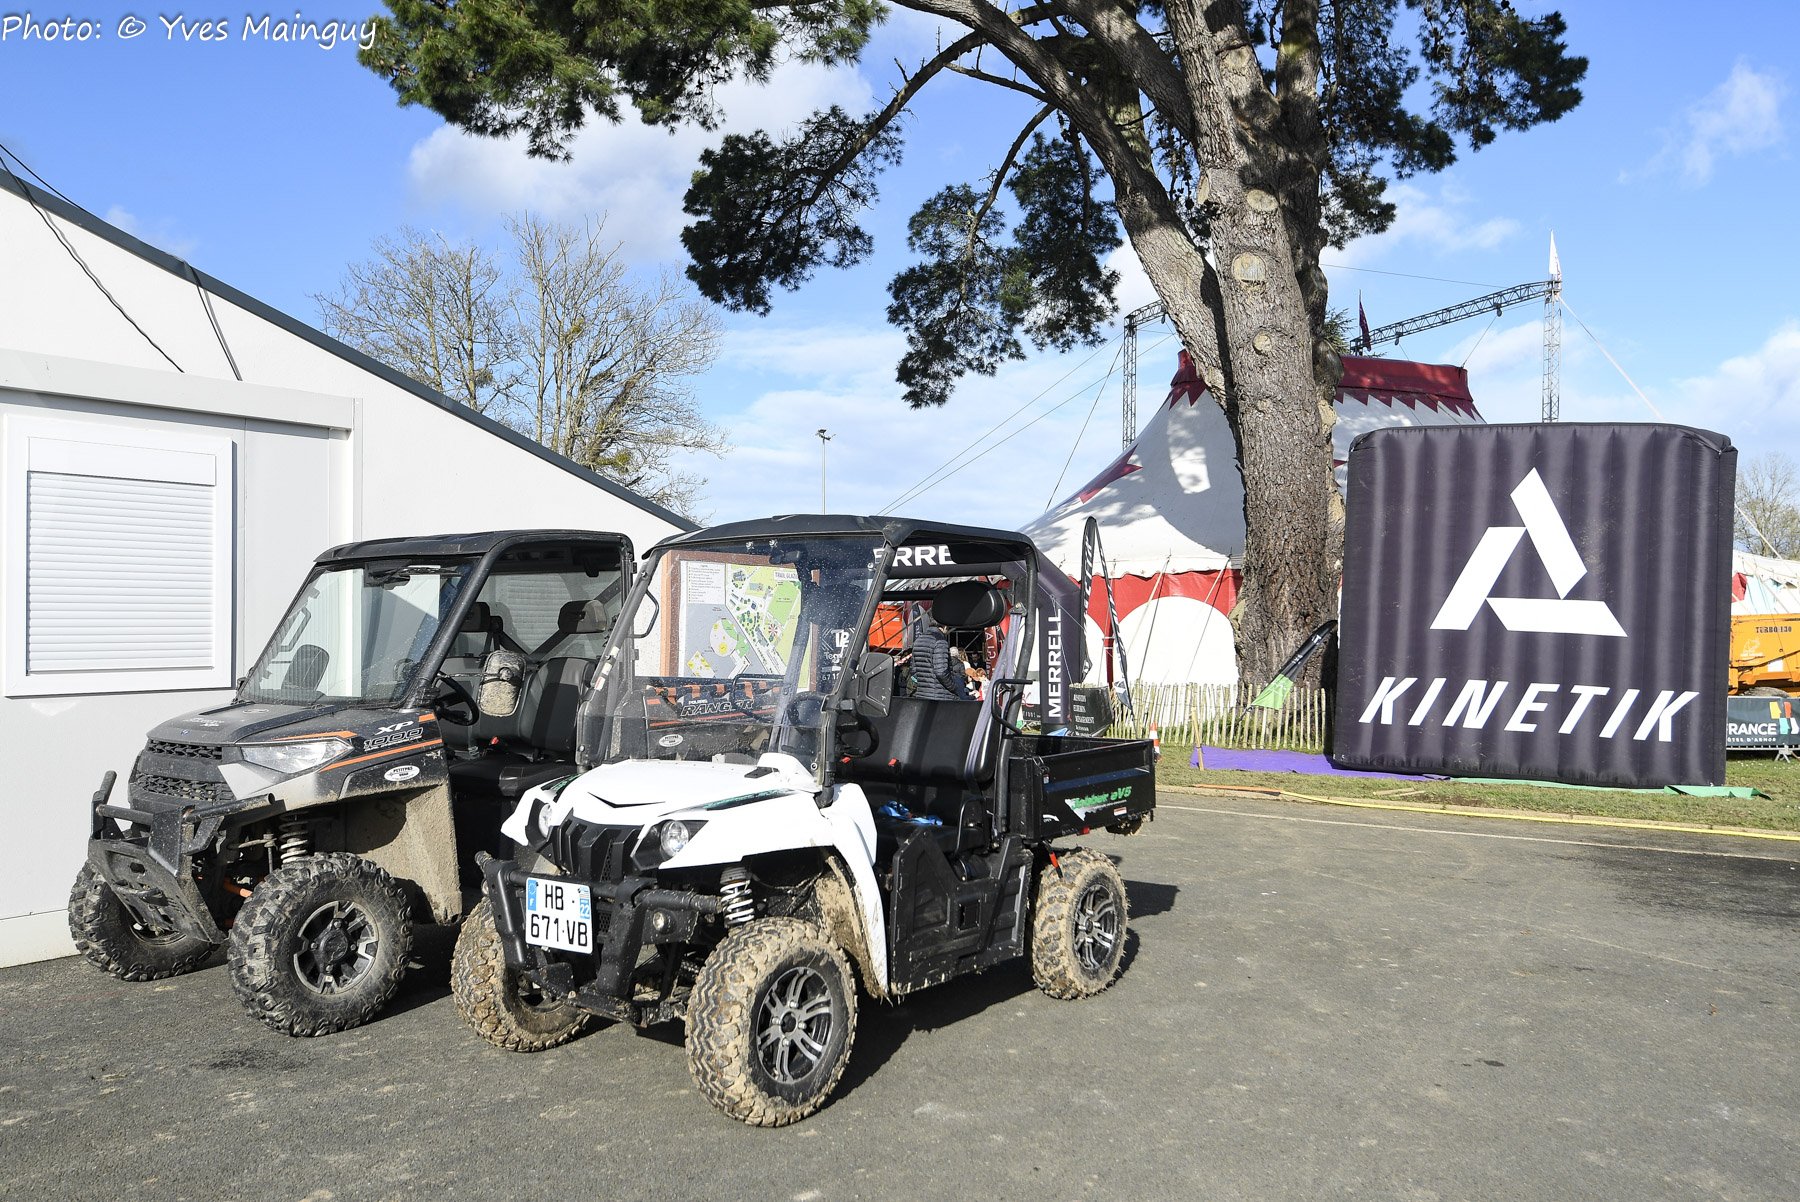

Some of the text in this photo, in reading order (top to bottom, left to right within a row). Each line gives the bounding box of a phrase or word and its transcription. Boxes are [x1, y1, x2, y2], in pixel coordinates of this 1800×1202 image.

[1048, 608, 1061, 718] MERRELL
[1358, 676, 1700, 743] KINETIK
[363, 727, 424, 750] 1000
[374, 720, 414, 736] XP
[1727, 722, 1777, 736] RANCE
[544, 883, 564, 911] HB
[580, 903, 591, 915] 22
